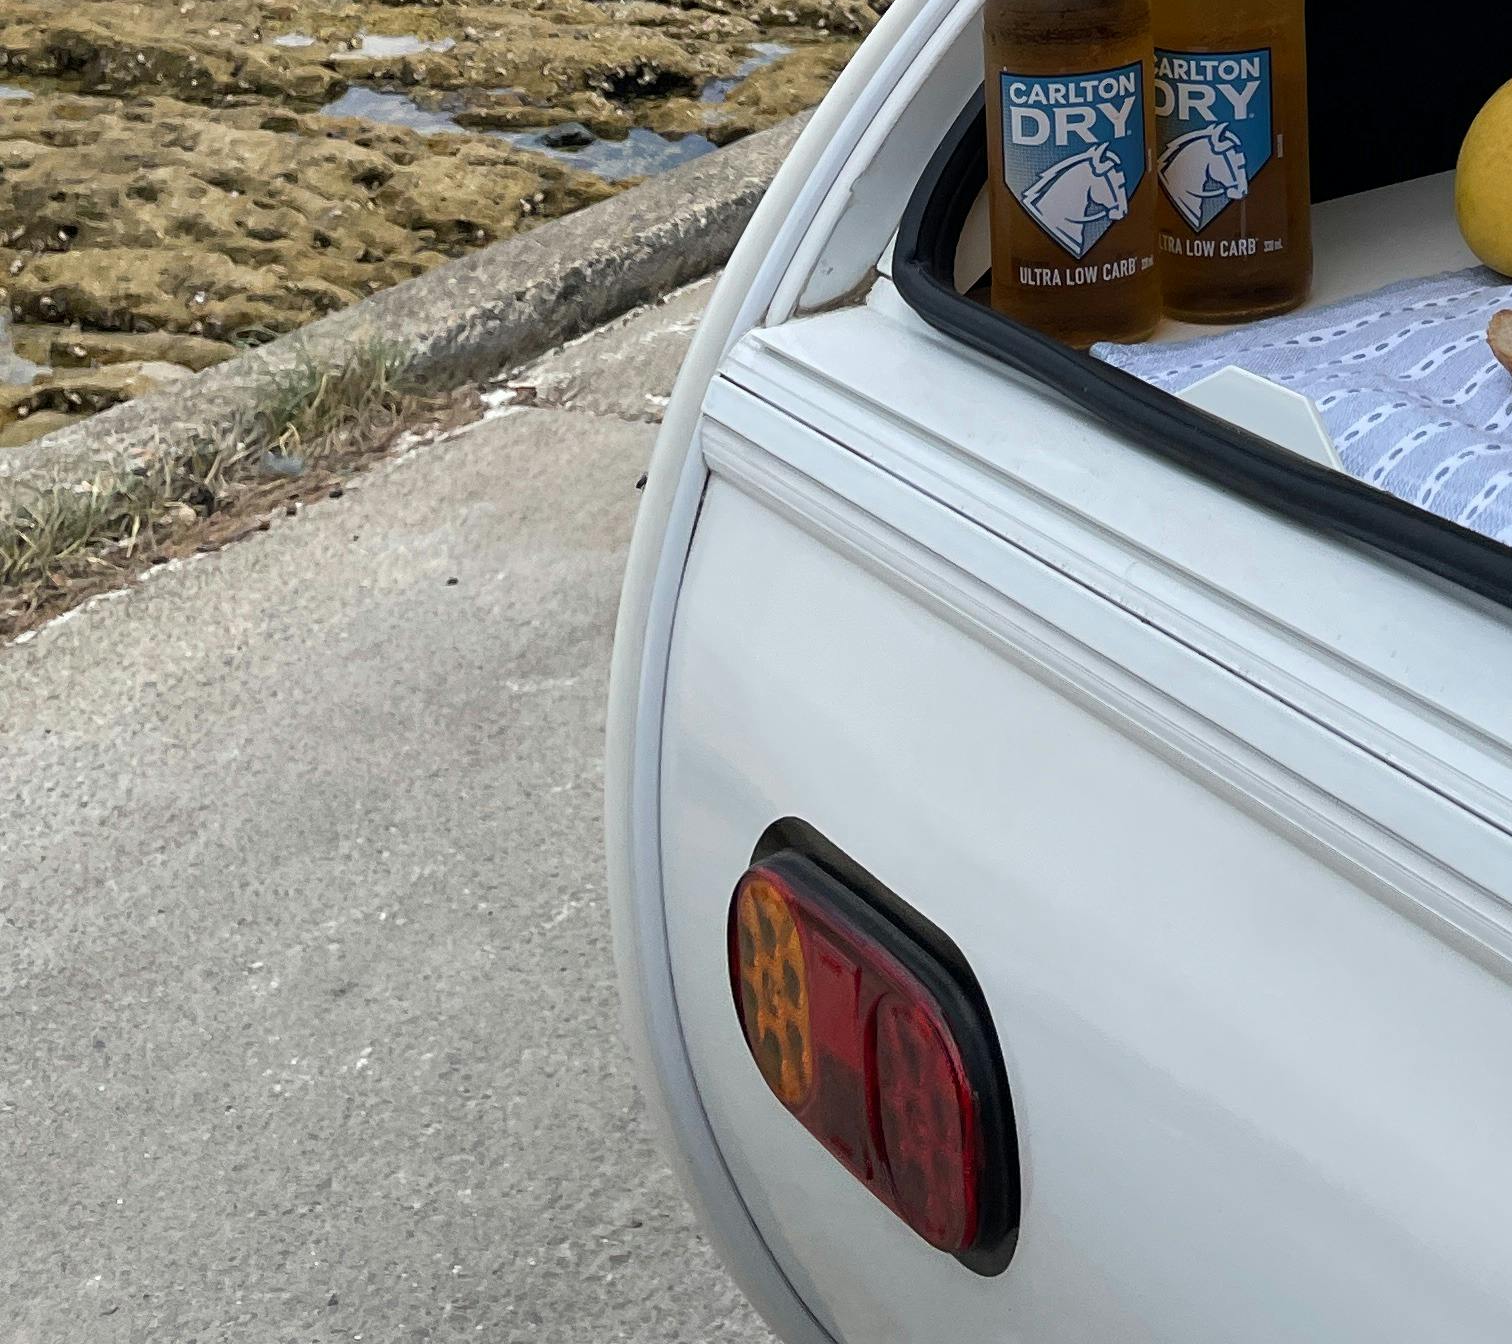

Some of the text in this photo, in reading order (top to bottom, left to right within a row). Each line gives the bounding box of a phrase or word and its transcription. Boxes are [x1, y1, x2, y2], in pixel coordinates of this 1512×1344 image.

[1154, 56, 1260, 81] ARLTON
[1009, 72, 1136, 105] CARLTON
[1010, 96, 1136, 146] DRY
[1159, 234, 1183, 255] LTRA
[1186, 239, 1215, 257] LOW
[1220, 238, 1256, 257] CARB
[1020, 267, 1062, 286] ULTRA
[1066, 266, 1098, 286] LOW
[1103, 257, 1136, 281] CARB
